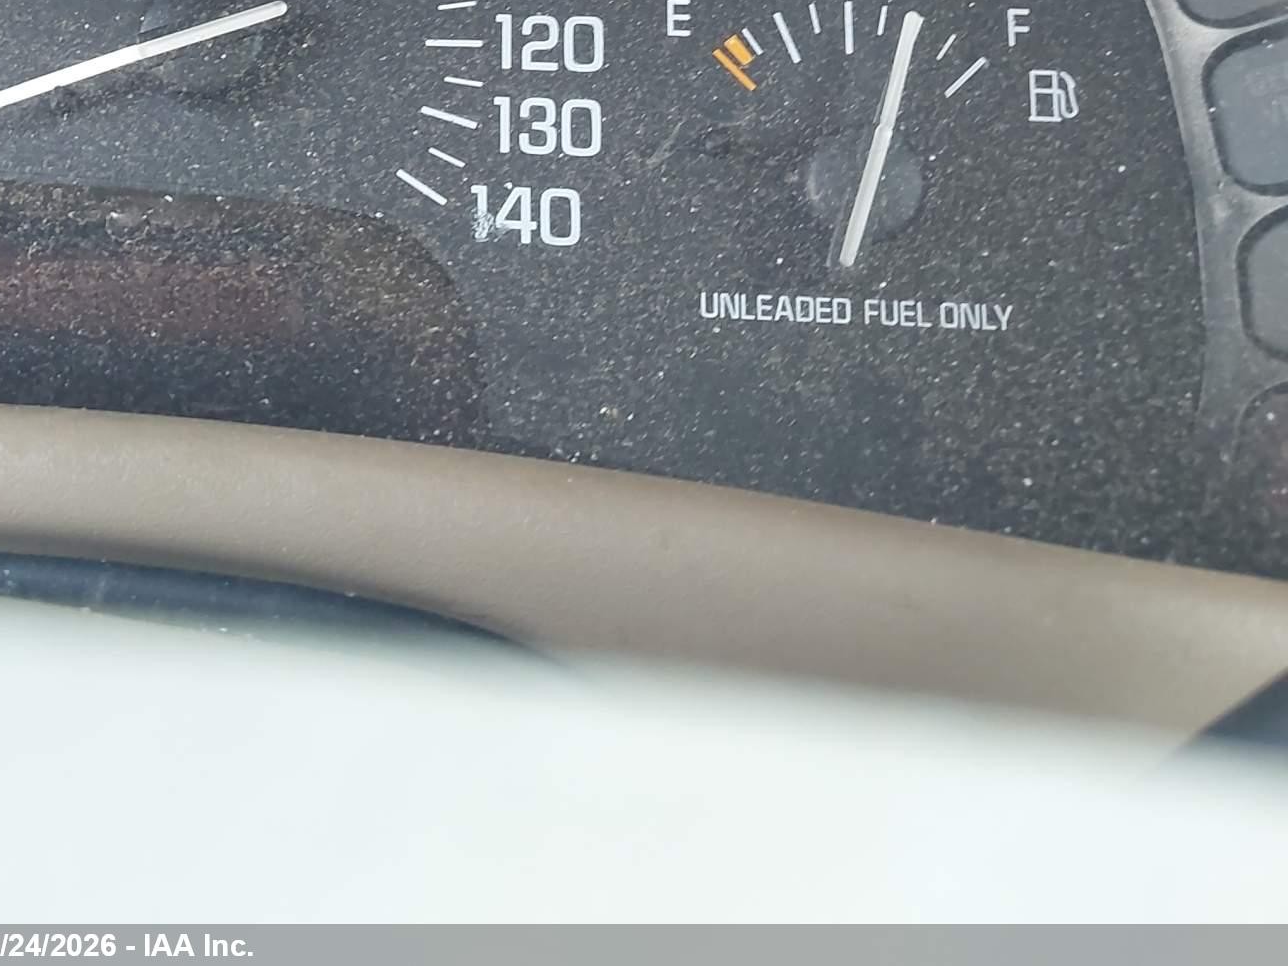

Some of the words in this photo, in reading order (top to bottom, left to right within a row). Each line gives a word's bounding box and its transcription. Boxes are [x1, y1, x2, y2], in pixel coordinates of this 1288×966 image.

[668, 0, 691, 36] E
[1007, 9, 1030, 46] F
[496, 15, 604, 72] 120
[495, 96, 602, 156] 130
[472, 186, 580, 245] 140
[700, 292, 852, 324] UNLEADED
[864, 299, 932, 328] FUEL
[940, 302, 1012, 331] ONLY
